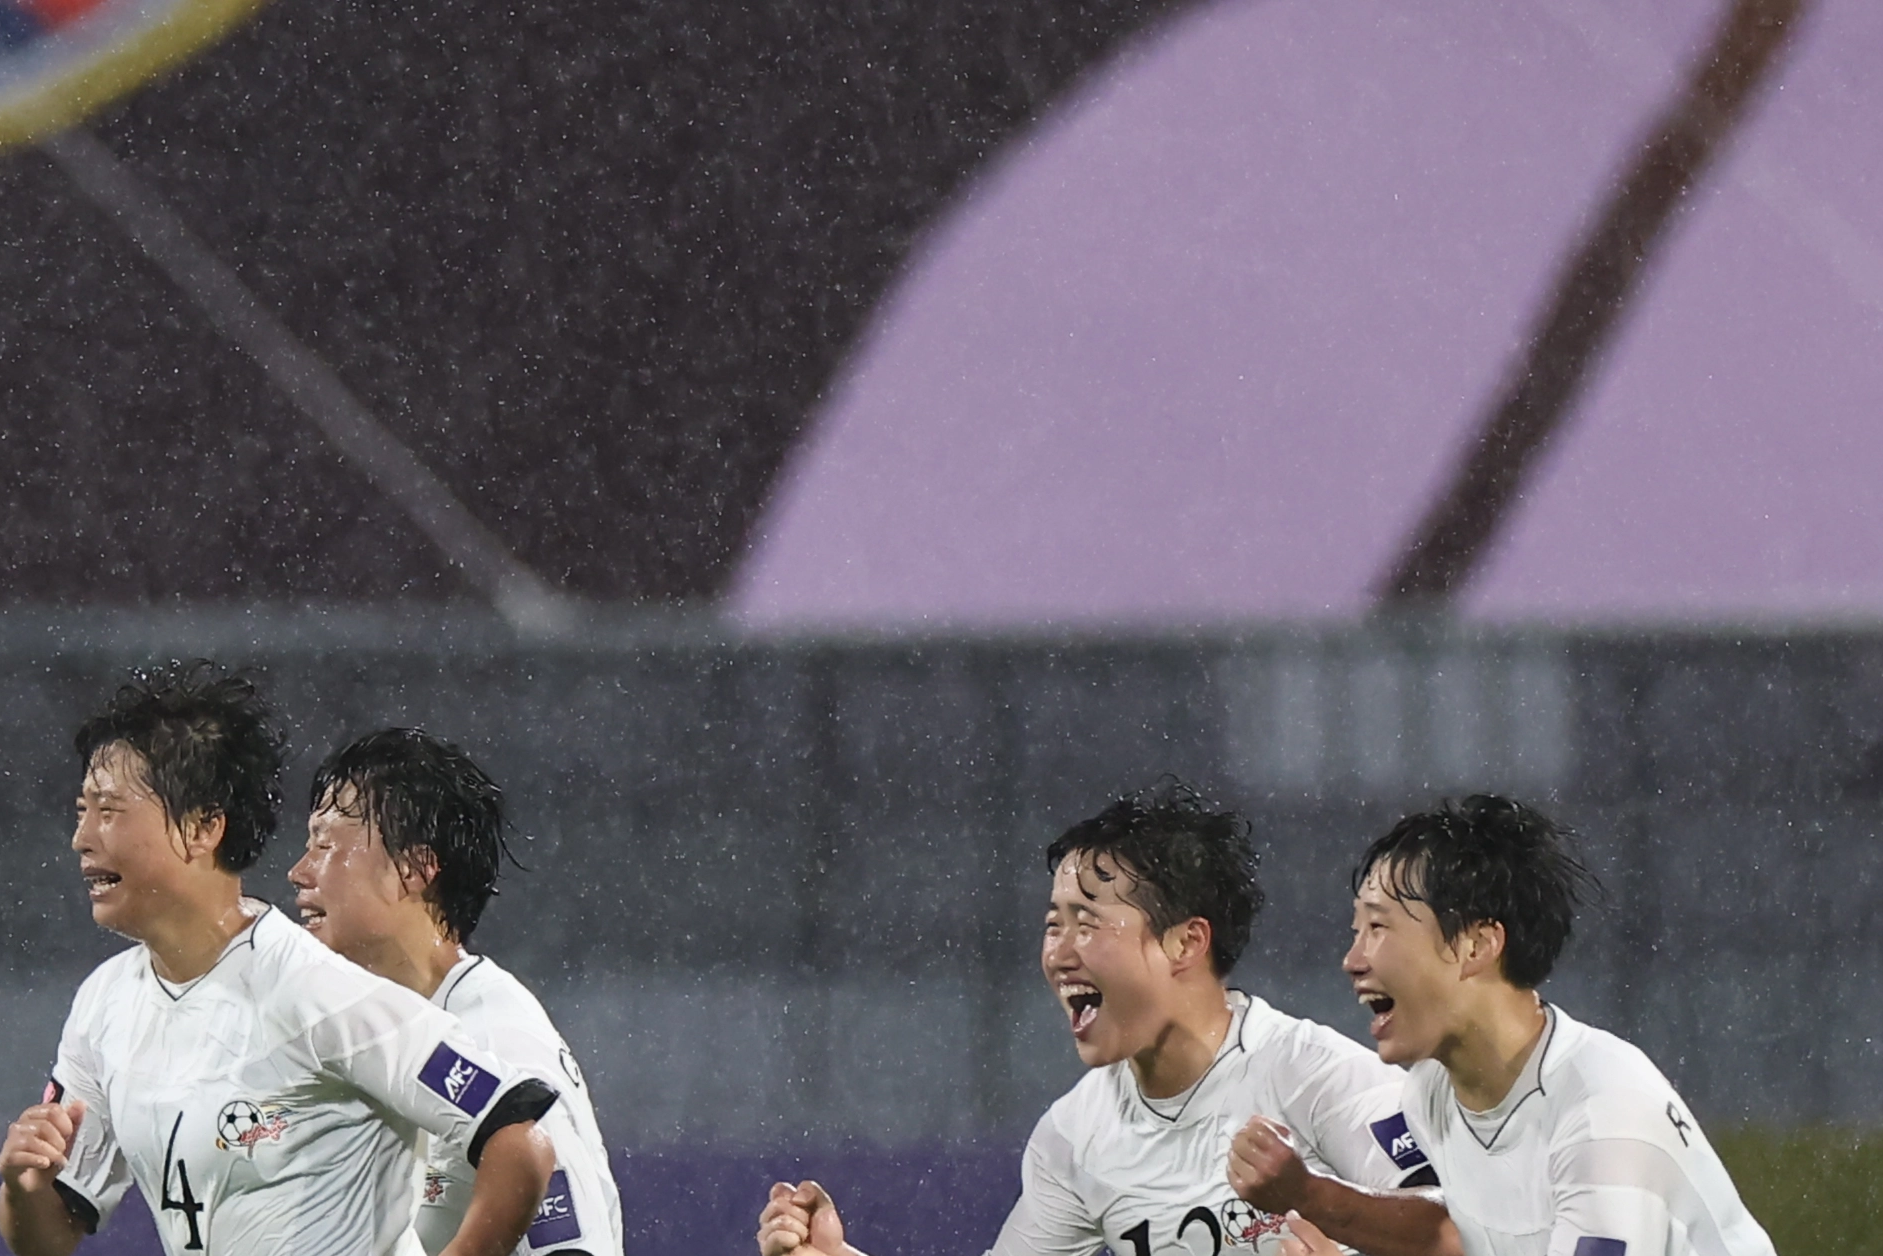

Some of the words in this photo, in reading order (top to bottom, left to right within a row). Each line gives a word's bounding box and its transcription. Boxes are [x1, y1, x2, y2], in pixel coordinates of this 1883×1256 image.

[444, 1056, 474, 1101] AFC
[1391, 1131, 1415, 1157] AF
[161, 1110, 204, 1250] 4
[538, 1194, 568, 1217] FC
